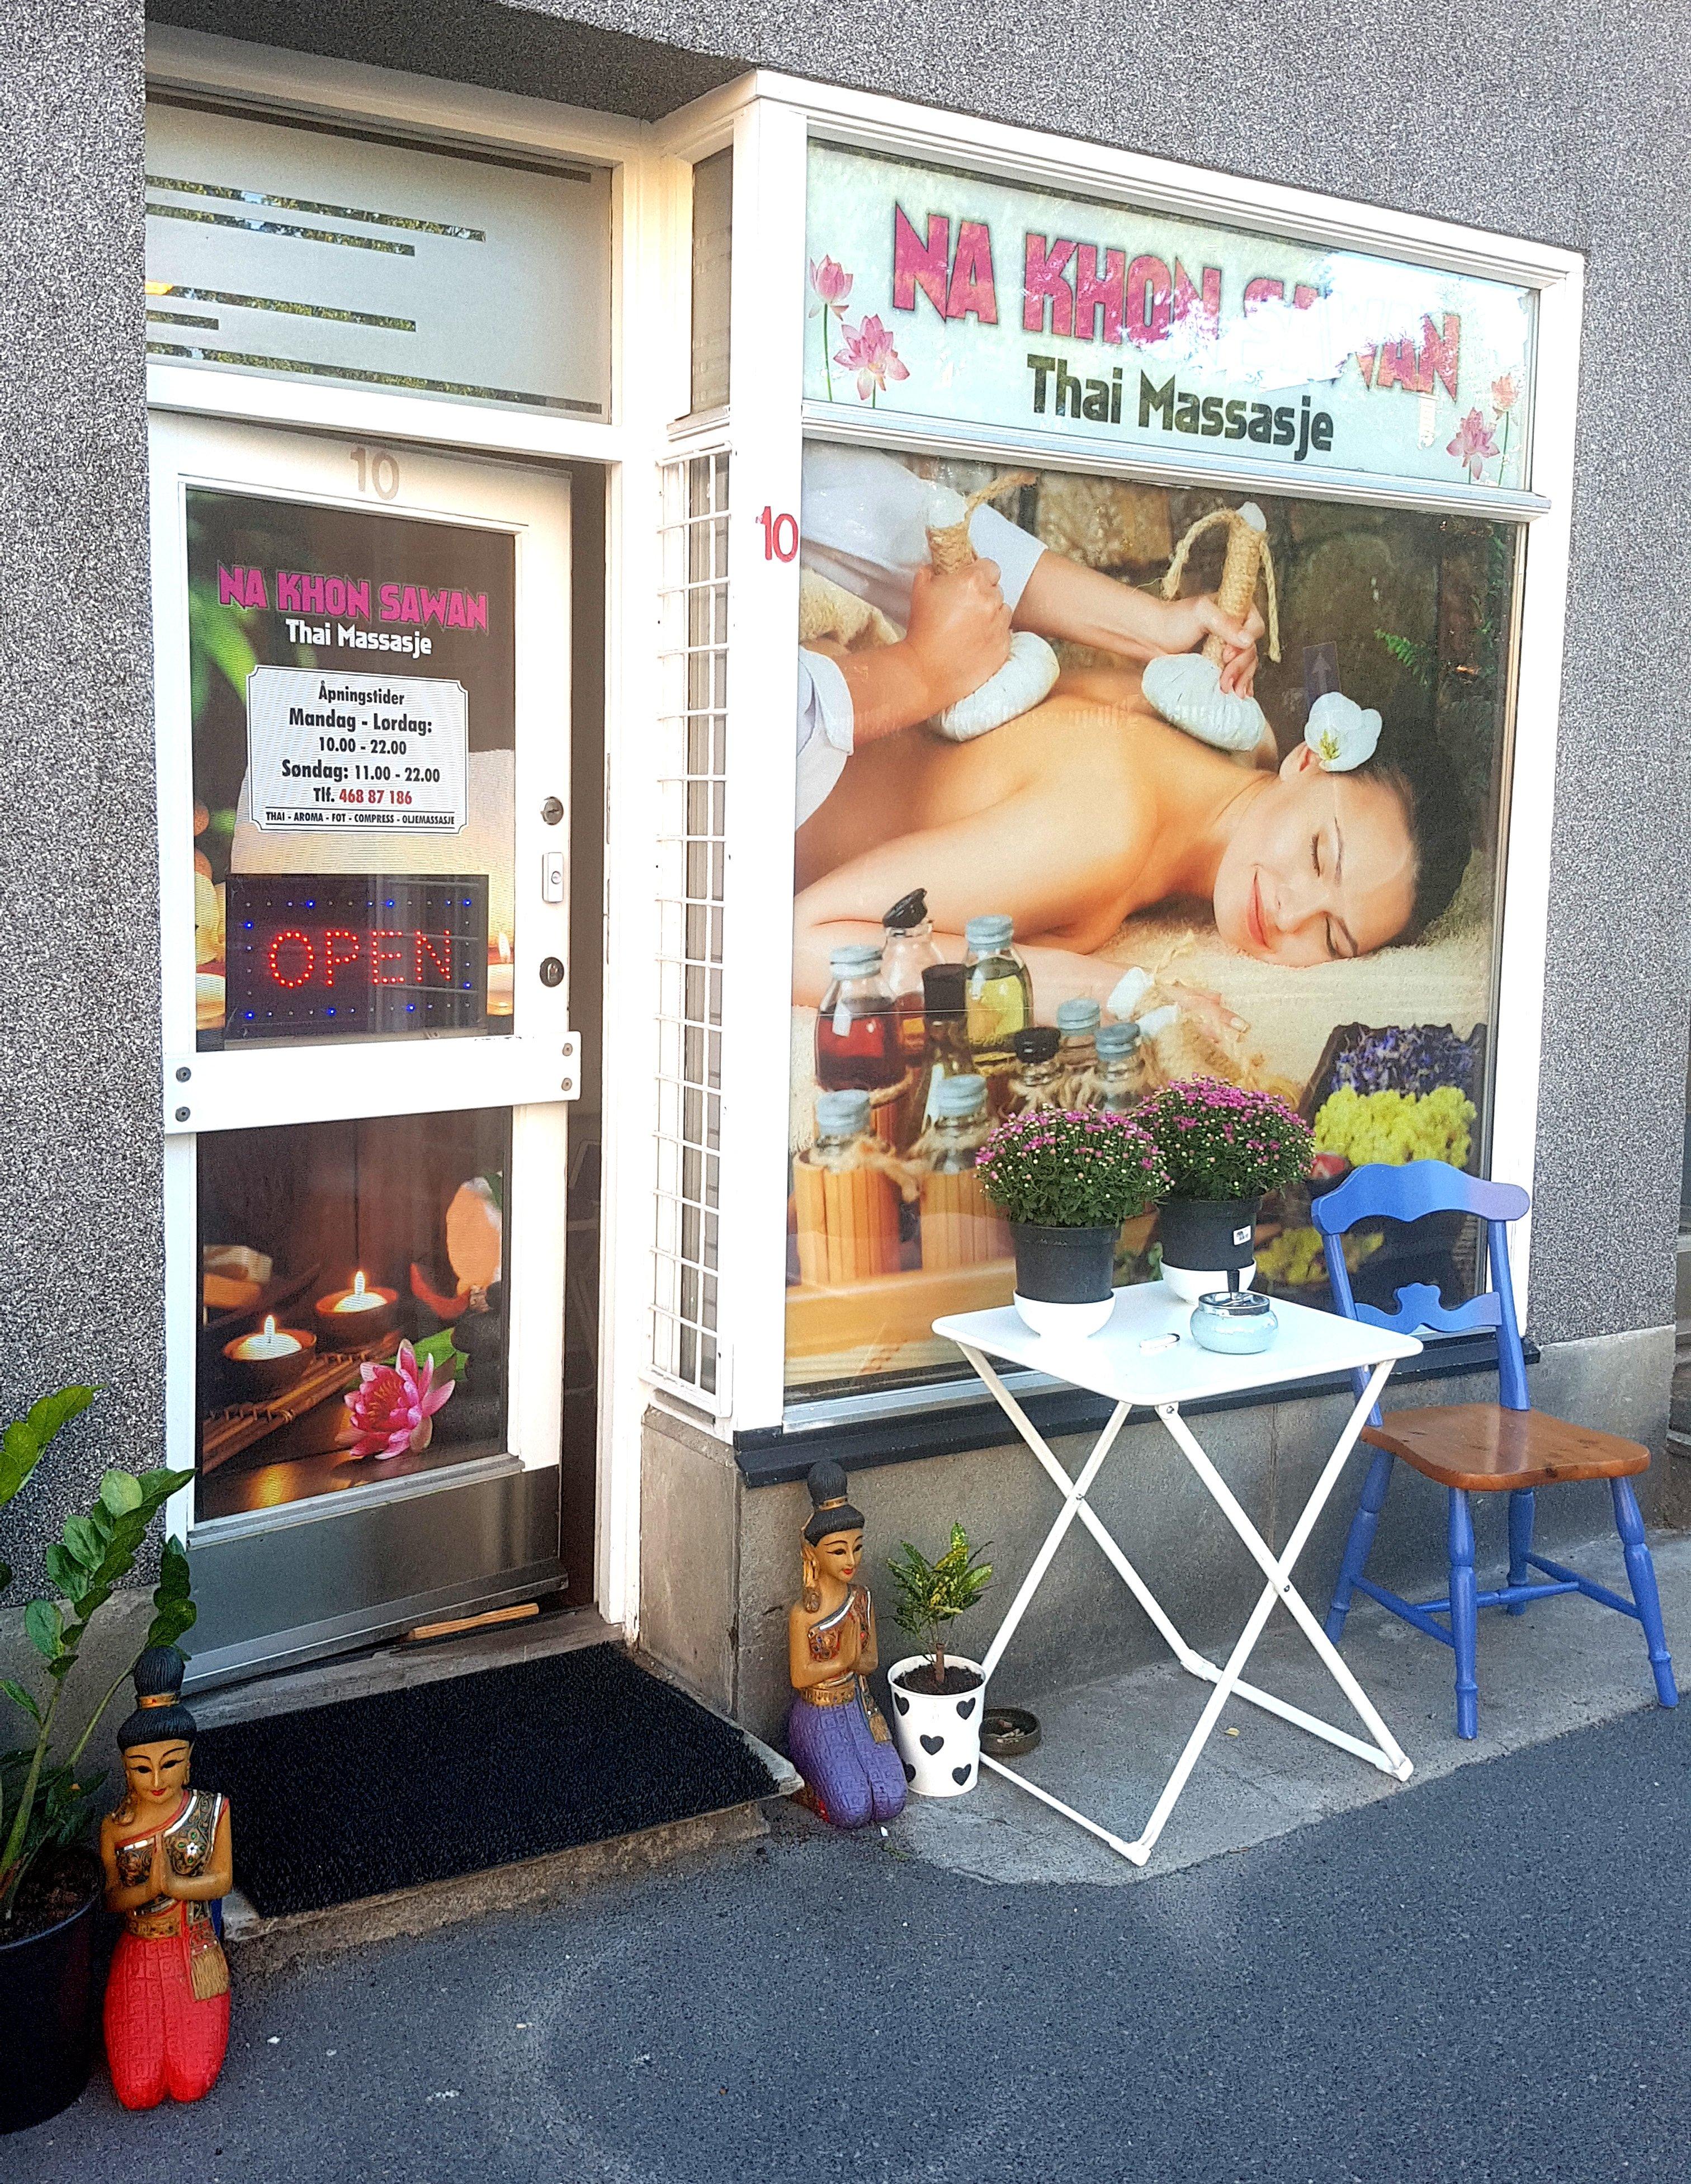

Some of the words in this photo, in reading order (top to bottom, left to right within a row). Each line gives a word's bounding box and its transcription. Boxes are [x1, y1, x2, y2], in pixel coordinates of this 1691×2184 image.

[893, 201, 998, 323] NA
[1022, 232, 1221, 351] KHON
[1027, 353, 1123, 424] Thai
[1139, 369, 1334, 461] Massasje
[350, 447, 399, 501] 10
[755, 506, 799, 563] 10
[218, 562, 268, 609] NA
[277, 571, 370, 621] KHON
[380, 583, 488, 634] SAWAN
[286, 618, 330, 645] Thai
[338, 622, 432, 659] Massasje
[318, 680, 405, 705] Åpningstider
[289, 707, 356, 732] Mandag
[374, 713, 432, 736] Lørdag:
[319, 737, 356, 752] 10.00
[370, 739, 407, 754] 22.00
[282, 759, 348, 782] Søndag:
[355, 765, 391, 780] 11.00
[405, 767, 440, 782] 22.00
[313, 787, 335, 802] Tlf.
[339, 789, 364, 803] 468
[368, 790, 385, 804] 87
[390, 790, 413, 804] 186
[266, 812, 285, 821] THAI
[294, 813, 324, 822] AROMA
[332, 814, 346, 822] FOT
[354, 814, 395, 823] COMPRESS
[402, 815, 455, 824] OLJEMASSASJE
[268, 928, 452, 989] OPEN
